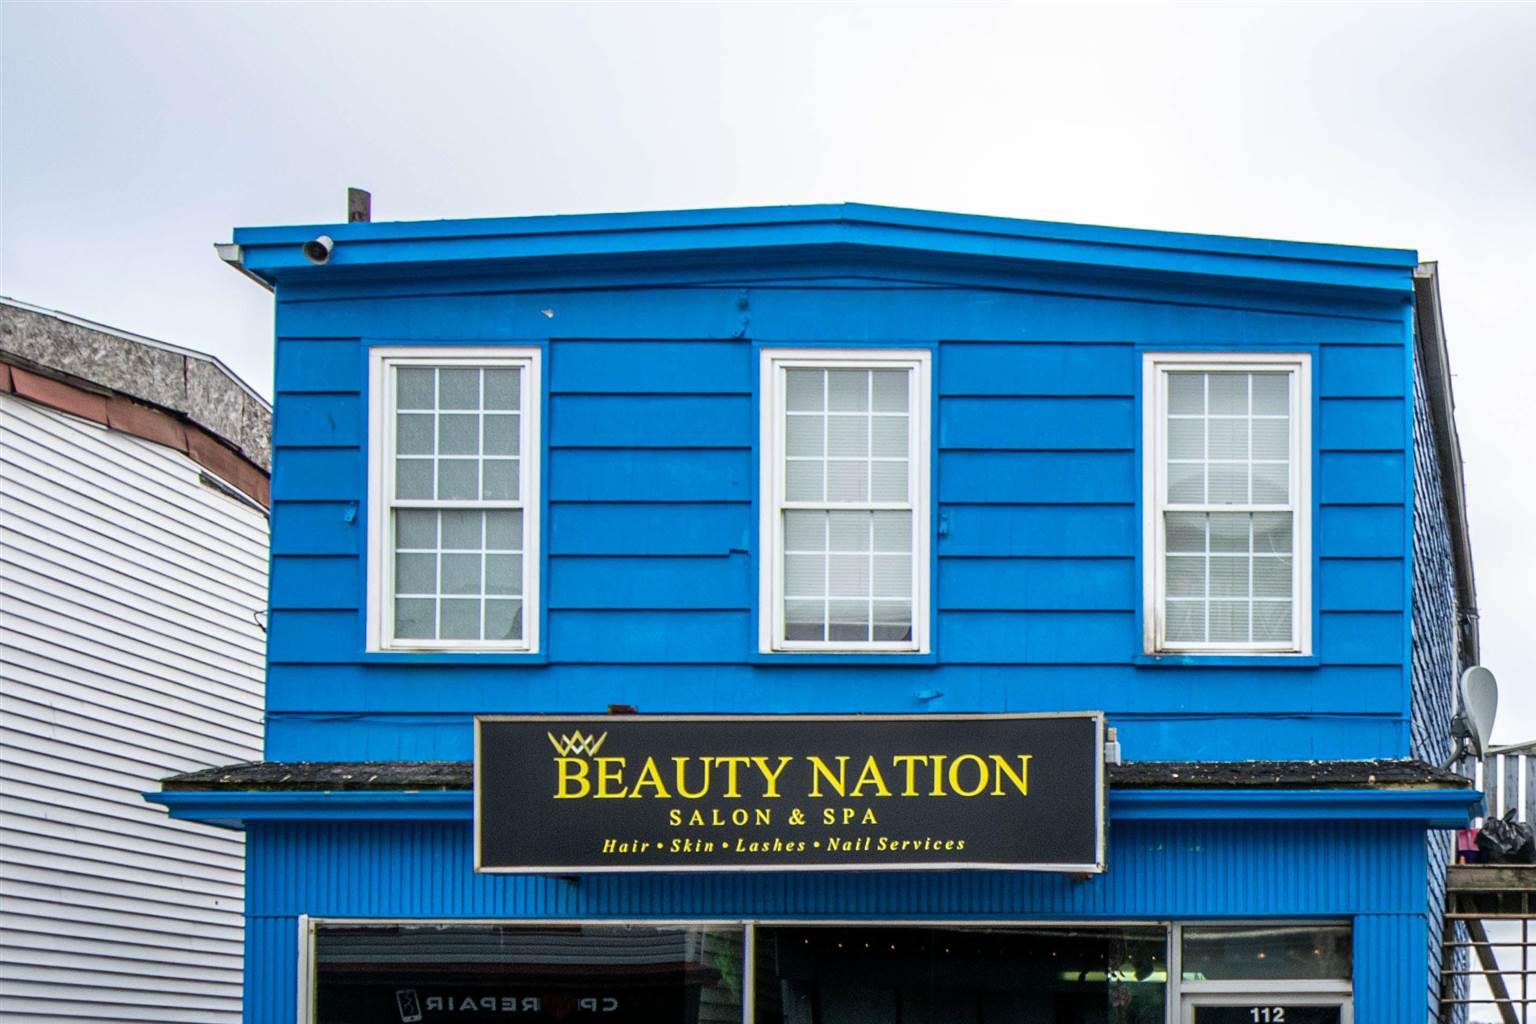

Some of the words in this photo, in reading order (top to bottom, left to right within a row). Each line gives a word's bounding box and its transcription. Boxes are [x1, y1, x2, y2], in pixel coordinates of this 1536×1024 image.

[553, 755, 792, 799] BEAUTY
[807, 754, 1032, 797] NATION
[669, 808, 772, 826] SALON
[788, 808, 806, 826] &
[823, 808, 878, 825] SPA
[602, 838, 649, 854] Hair
[670, 838, 715, 854] Skin
[736, 837, 806, 853] Lashes
[827, 836, 872, 852] Nail
[877, 836, 966, 852] Services
[1250, 1007, 1285, 1023] 112
